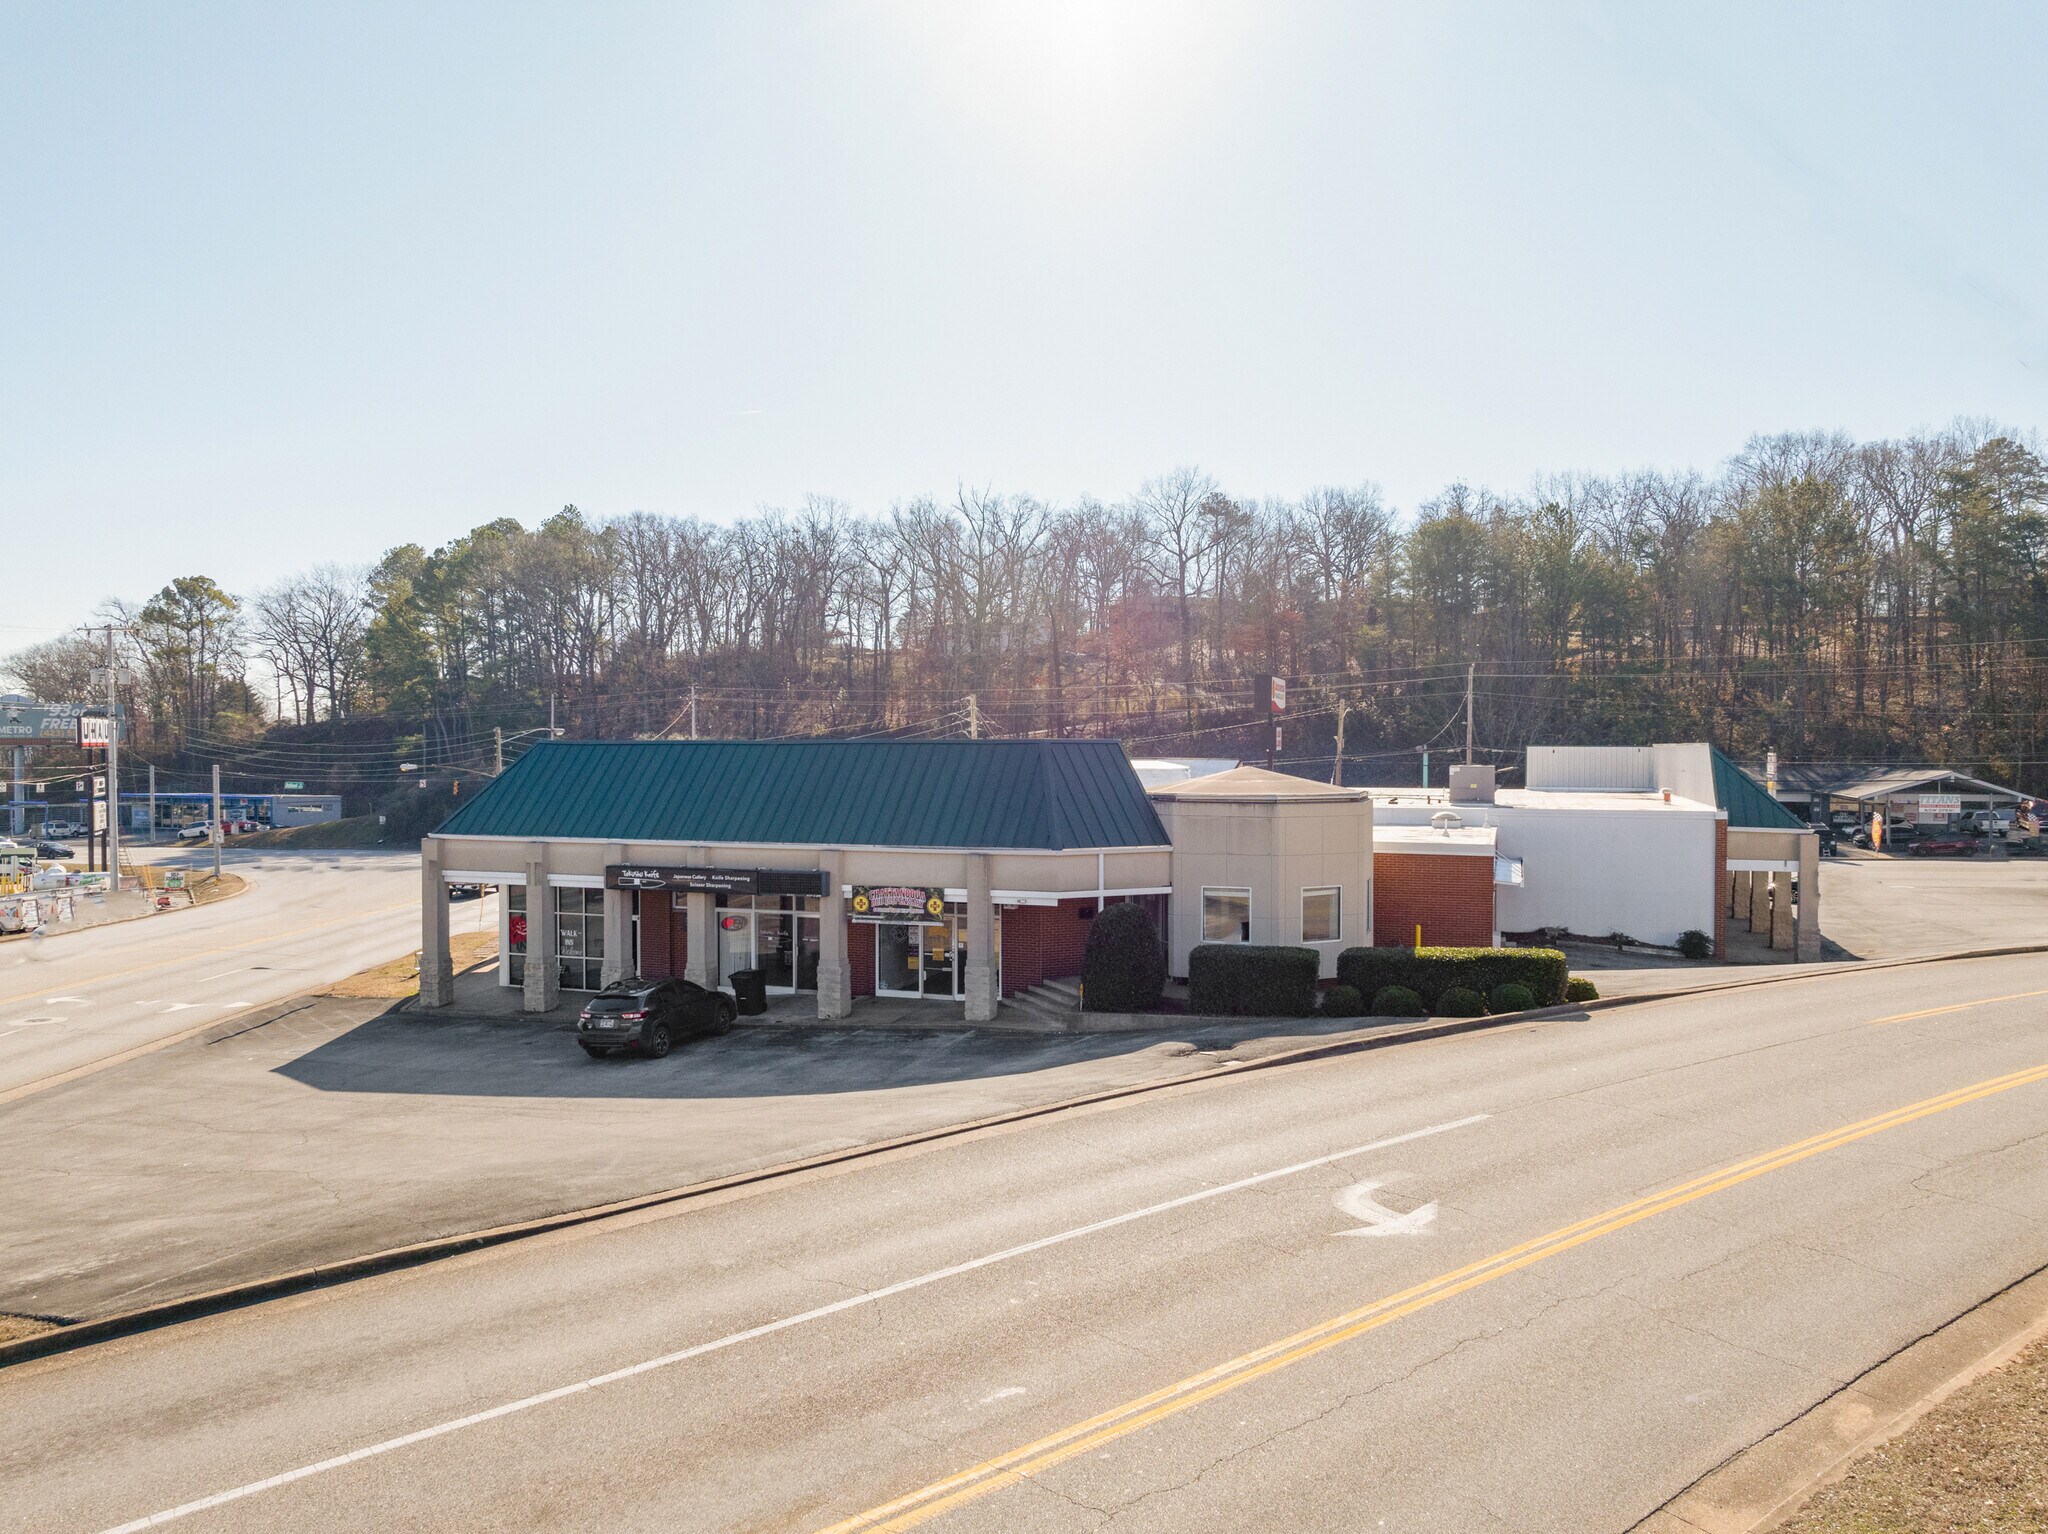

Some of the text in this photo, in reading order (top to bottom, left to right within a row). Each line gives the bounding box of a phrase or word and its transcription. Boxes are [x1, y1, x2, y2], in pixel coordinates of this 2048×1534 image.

[40, 718, 77, 730] FREE
[0, 725, 33, 734] METRO
[644, 870, 660, 878] Knife
[564, 938, 575, 946] INS
